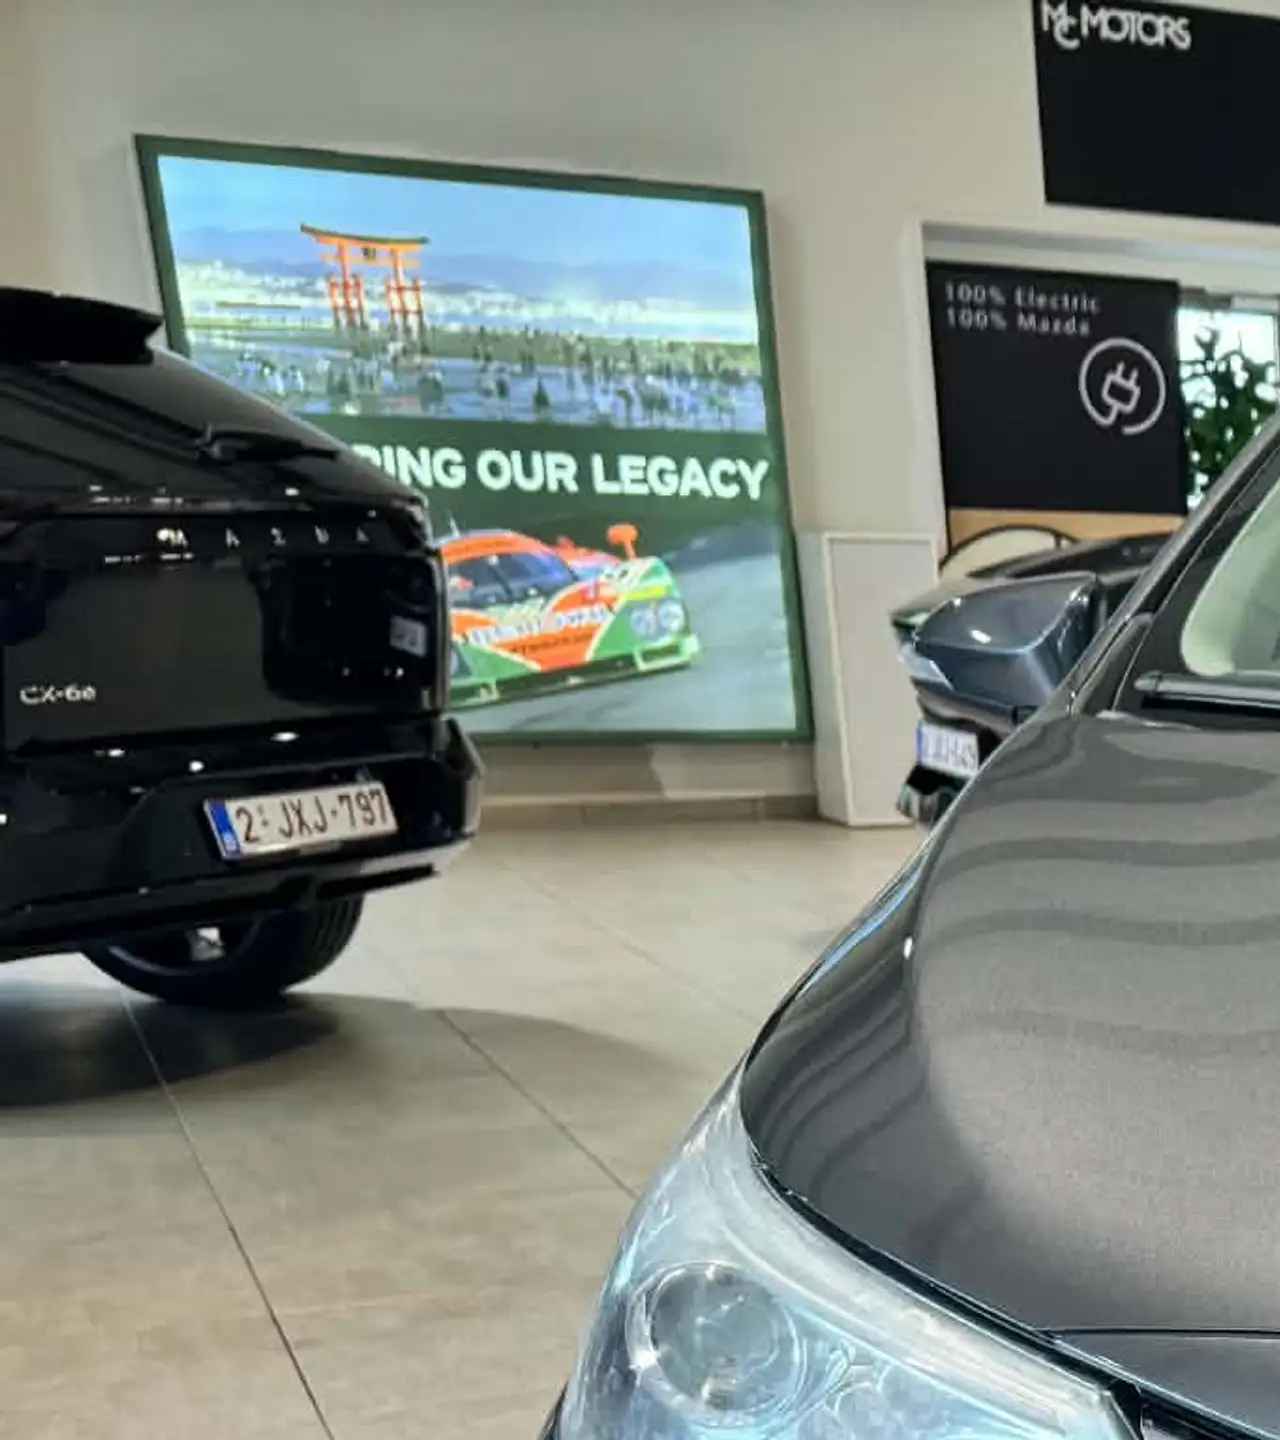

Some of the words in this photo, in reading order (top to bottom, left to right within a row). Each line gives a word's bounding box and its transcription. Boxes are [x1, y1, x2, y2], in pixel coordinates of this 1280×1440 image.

[1041, 2, 1081, 50] MC
[1081, 4, 1192, 50] MOTORS
[945, 281, 1006, 306] 100%
[1014, 285, 1101, 314] Electric
[947, 306, 1008, 331] 100%
[1016, 310, 1091, 336] Mazda
[476, 450, 579, 494] OUR
[591, 452, 769, 500] LEGACY
